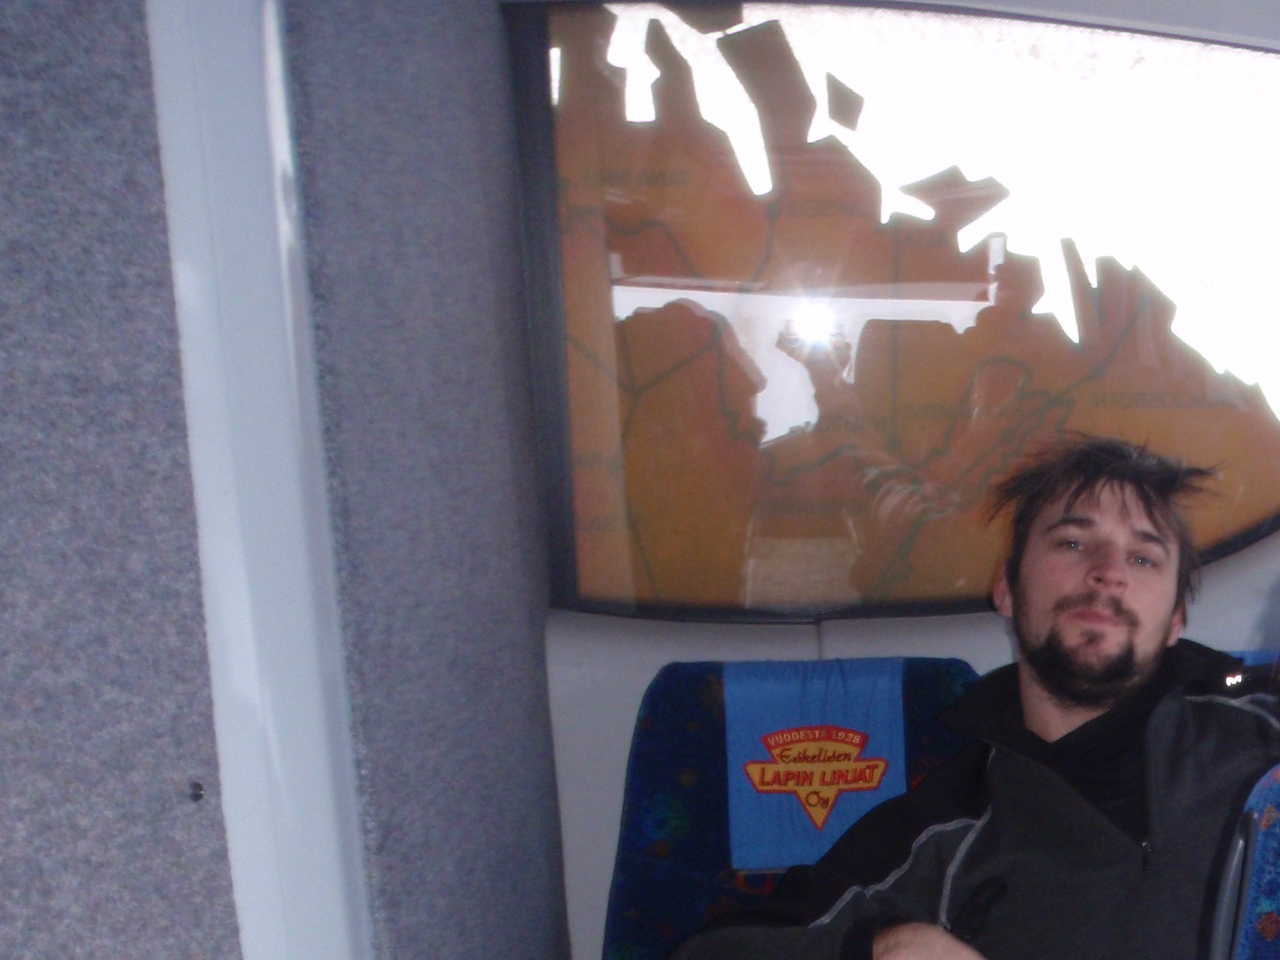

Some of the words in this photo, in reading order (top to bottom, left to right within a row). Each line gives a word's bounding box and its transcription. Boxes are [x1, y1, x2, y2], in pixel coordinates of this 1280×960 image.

[767, 729, 828, 747] VUODESTA
[832, 730, 862, 745] 1928
[759, 767, 815, 787] LAPIN
[819, 763, 880, 787] LINJAT
[805, 790, 830, 809] Oy
